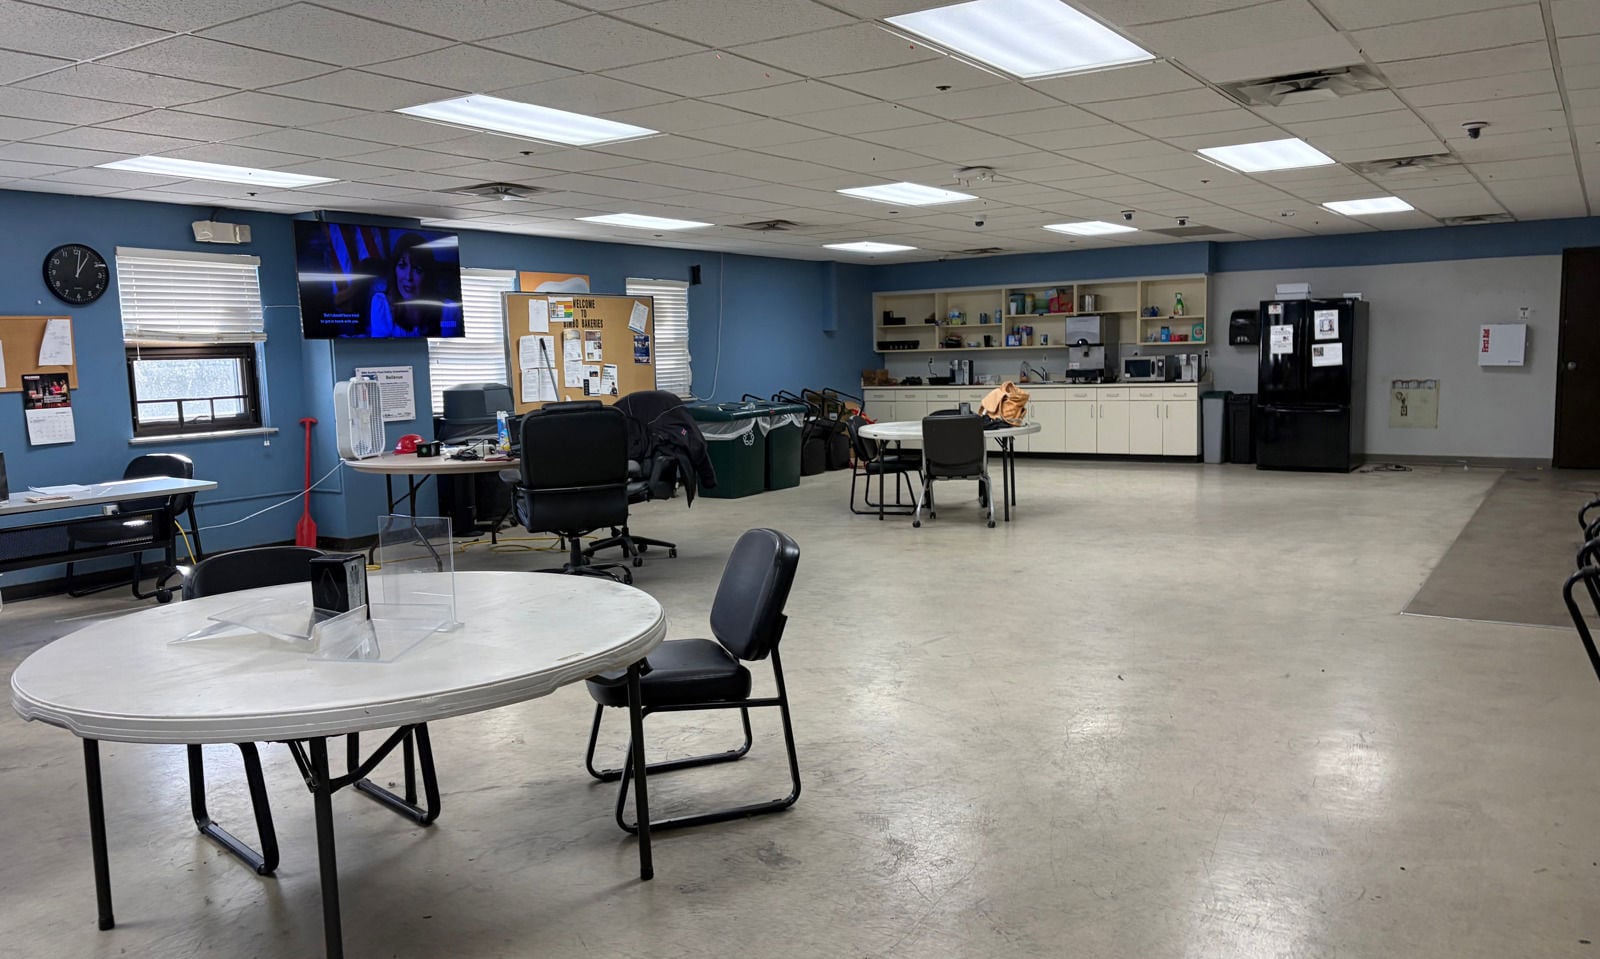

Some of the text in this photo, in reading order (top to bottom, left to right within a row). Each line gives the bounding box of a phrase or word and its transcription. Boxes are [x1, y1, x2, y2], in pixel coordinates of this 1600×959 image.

[573, 300, 595, 308] WELCOME
[581, 309, 587, 318] TO
[582, 319, 603, 328] BAKERIES
